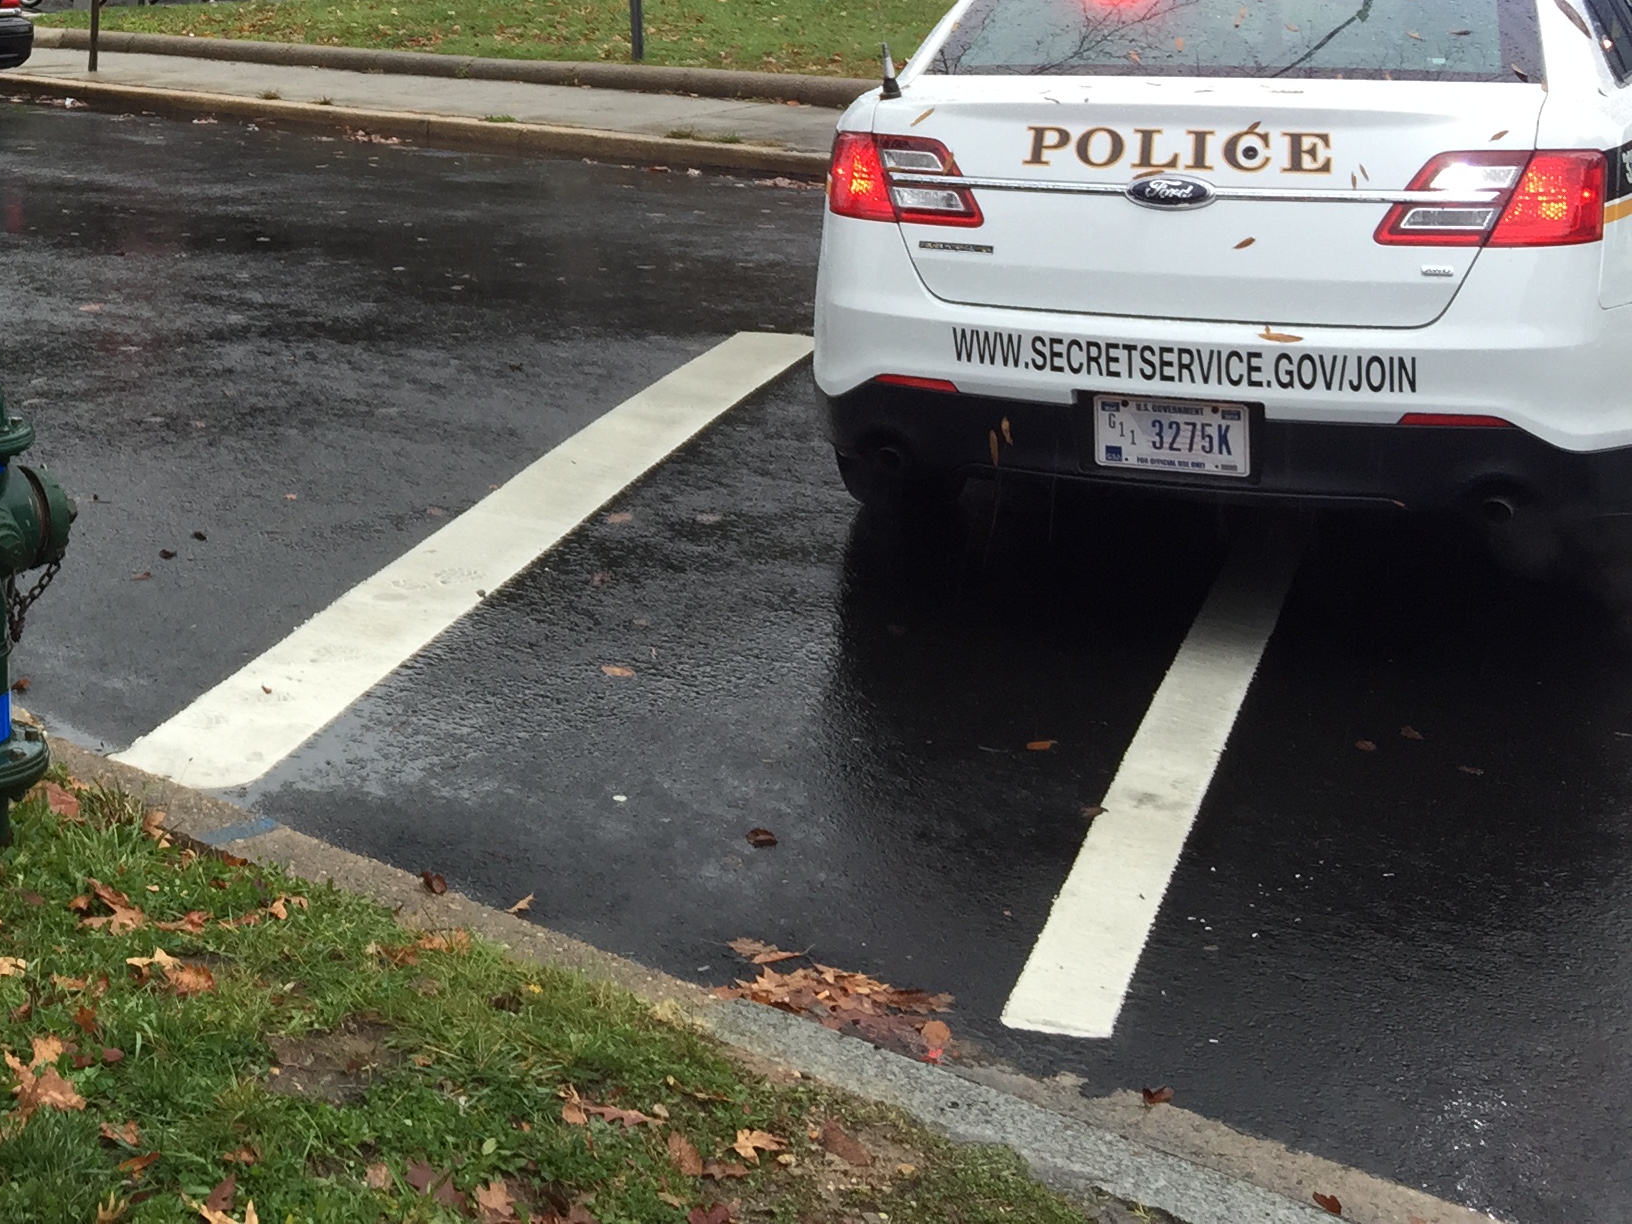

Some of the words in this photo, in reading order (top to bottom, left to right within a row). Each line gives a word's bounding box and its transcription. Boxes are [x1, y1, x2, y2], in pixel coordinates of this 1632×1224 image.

[1021, 125, 1333, 175] POLICE
[1144, 179, 1193, 199] Ford
[952, 326, 1418, 393] WWW.SECRETSERVICE.GOV/JOIN
[1151, 404, 1204, 416] GOVERNMENT
[1150, 419, 1233, 456] 3275K
